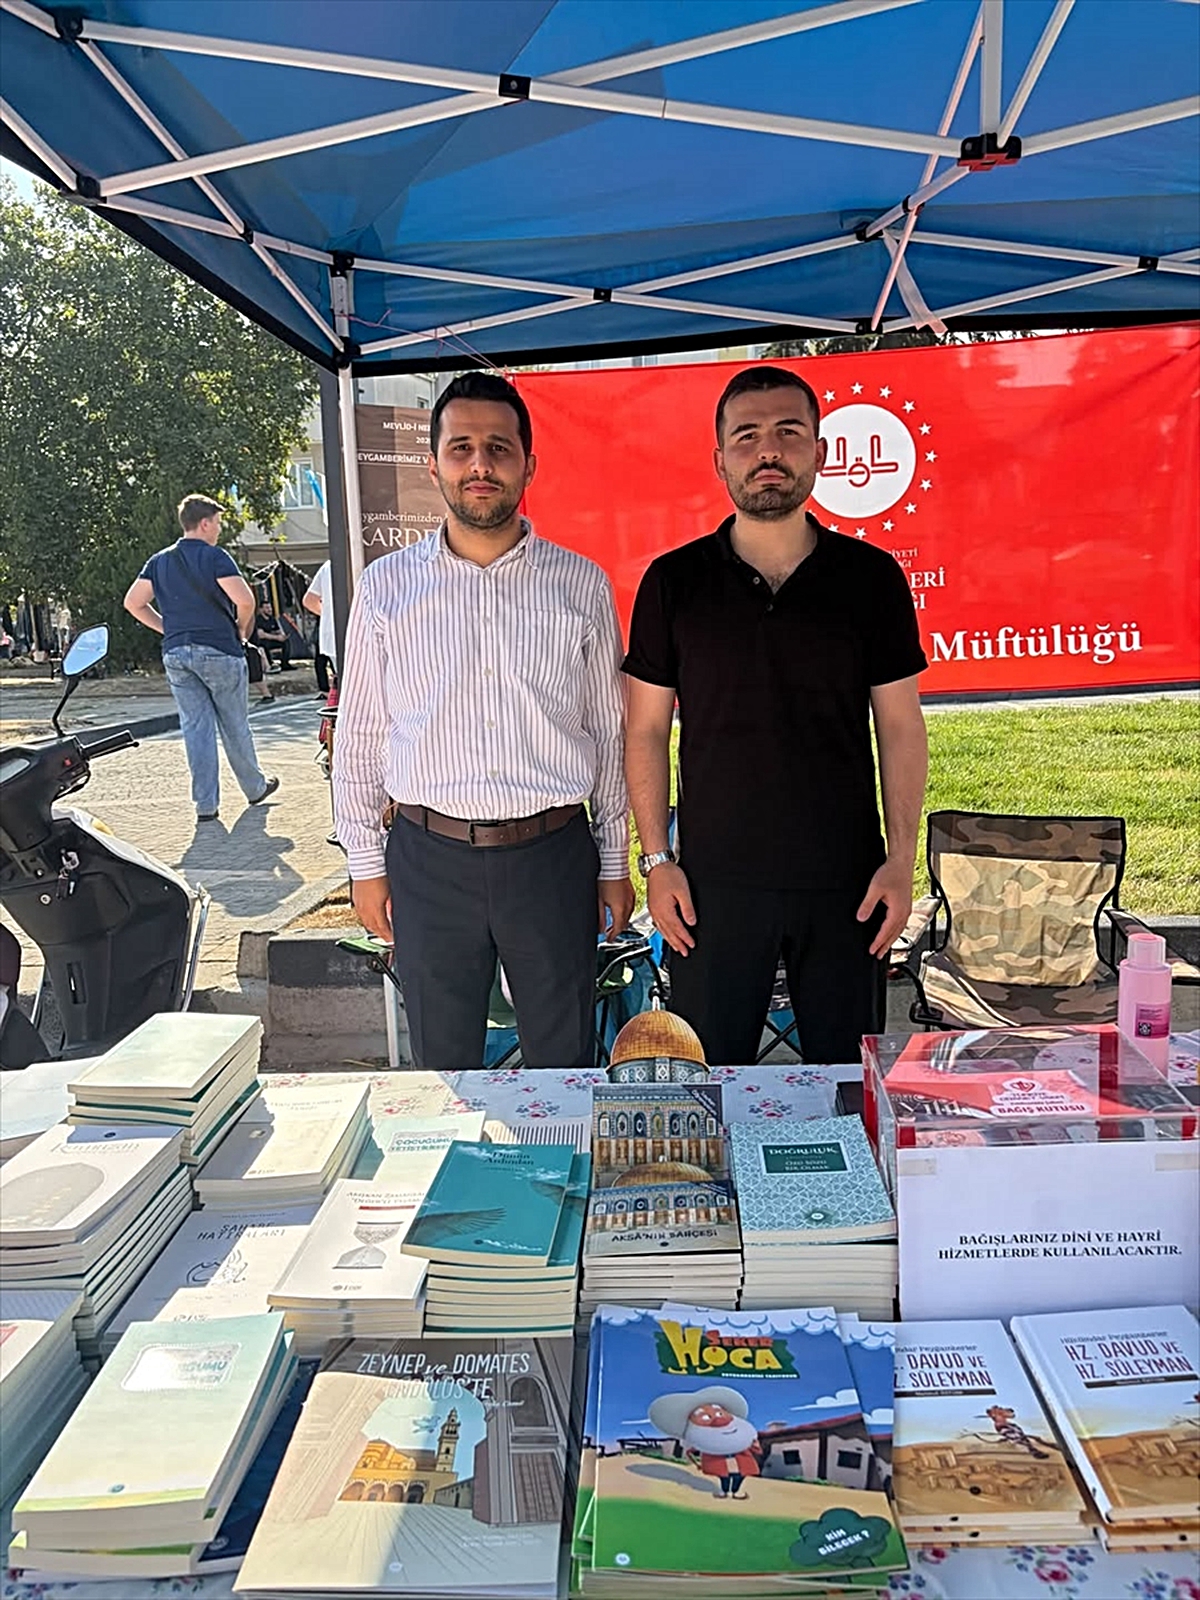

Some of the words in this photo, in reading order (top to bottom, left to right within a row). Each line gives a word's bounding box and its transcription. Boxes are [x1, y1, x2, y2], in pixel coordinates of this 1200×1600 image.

[357, 452, 421, 464] EYGAMBERİMİZ
[361, 510, 443, 524] ygamberimizden
[930, 622, 1143, 664] Müftülüğü
[998, 1106, 1034, 1116] BAĞIŞ
[1037, 1104, 1086, 1114] KUTUSU
[959, 1231, 1059, 1247] BAĞIŞLARINIZ
[1062, 1230, 1093, 1243] DİNİ
[1096, 1231, 1115, 1243] VE
[1117, 1227, 1162, 1242] HAYRİ
[938, 1246, 1040, 1260] HİZMETLERDE
[1042, 1244, 1183, 1258] KULLANILACAKTIR.
[660, 1320, 782, 1374] HOCA
[1065, 1344, 1099, 1361] HZ.
[1097, 1339, 1159, 1359] DAVUD
[1160, 1341, 1183, 1354] VE
[356, 1353, 426, 1374] ZEYNEP
[426, 1363, 448, 1376] ve
[452, 1352, 531, 1374] DOMATES
[907, 1352, 964, 1370] DAVUD
[967, 1355, 987, 1369] VE
[1075, 1363, 1105, 1380] HZ.
[1105, 1356, 1194, 1377] SÜLEYMAN
[908, 1370, 993, 1388] SÜLEYMAN
[818, 1534, 862, 1555] BİLECEK
[825, 1529, 846, 1541] KİM
